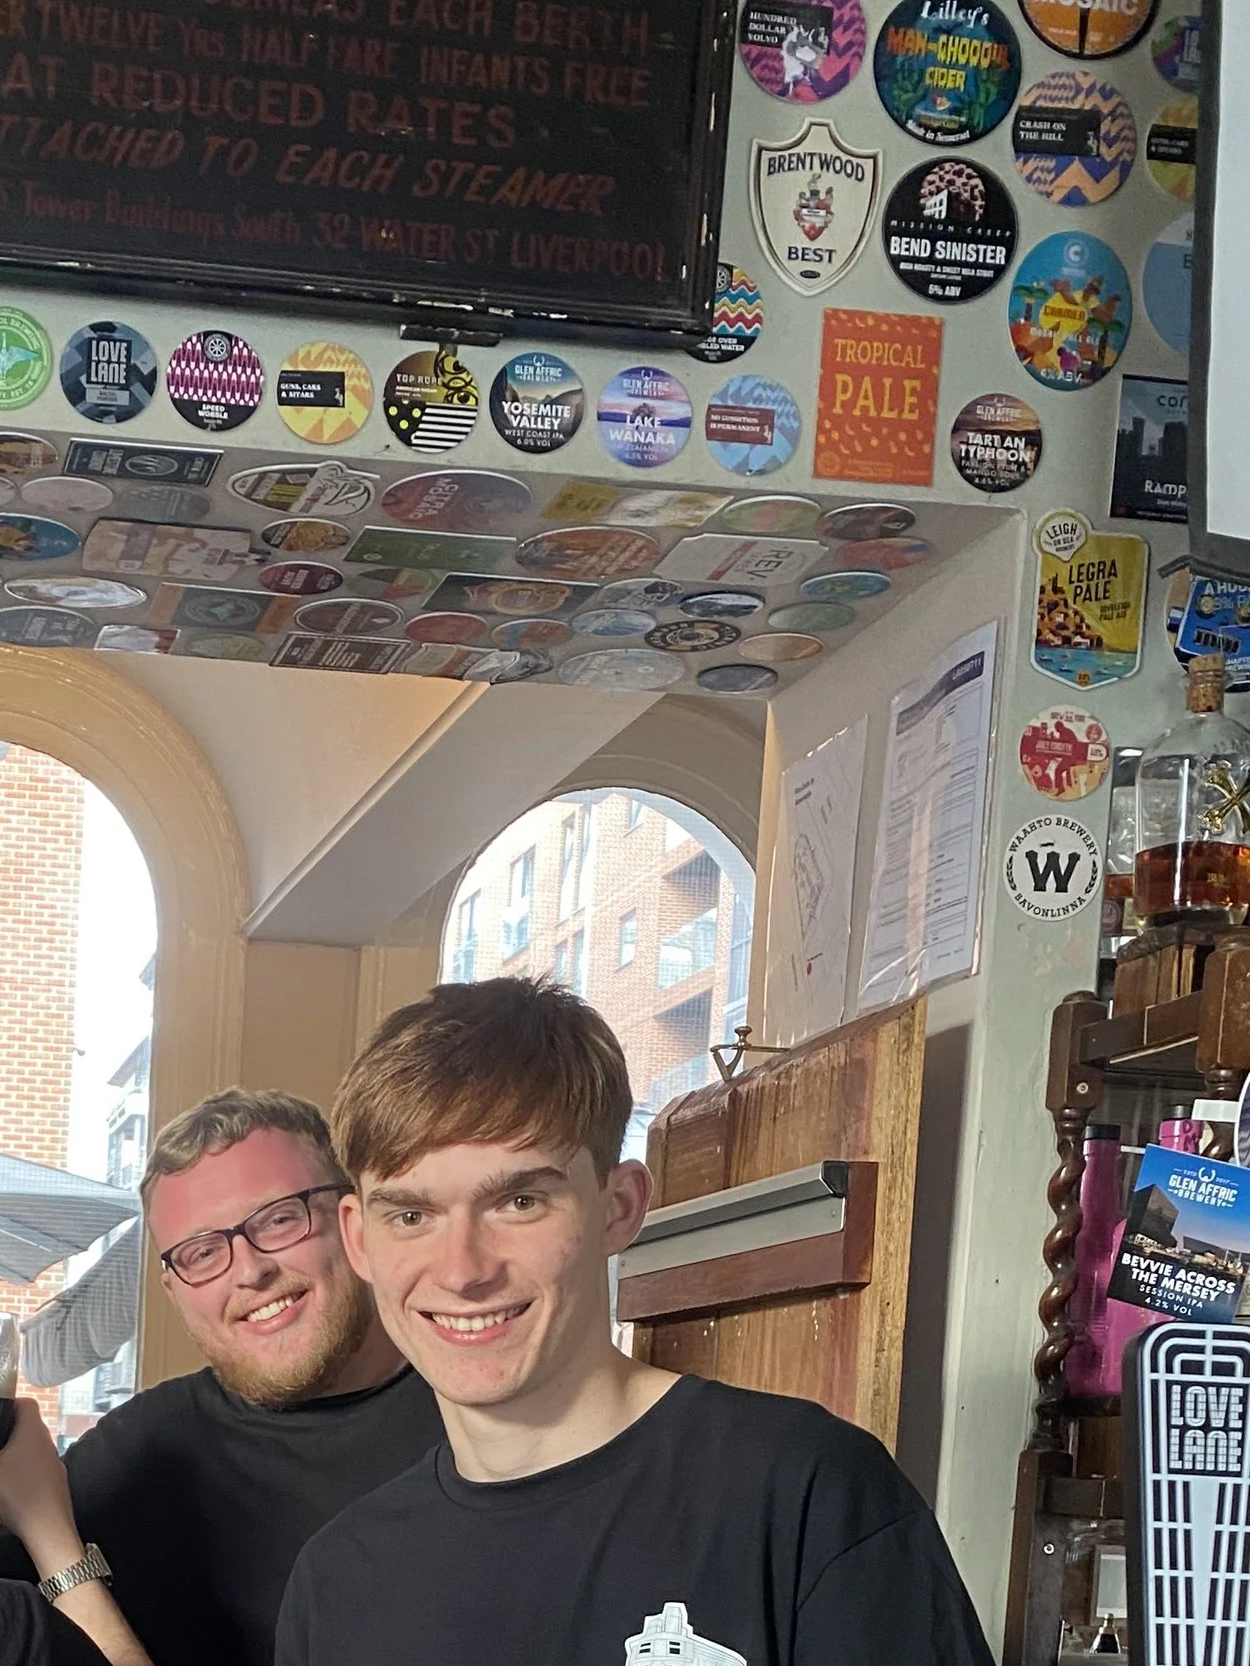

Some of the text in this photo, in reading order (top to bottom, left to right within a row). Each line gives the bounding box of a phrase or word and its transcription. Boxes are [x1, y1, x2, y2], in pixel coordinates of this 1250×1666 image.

[513, 1, 651, 56] BERTH
[420, 46, 550, 96] INFANTS
[564, 60, 651, 108] FREE
[0, 51, 62, 101] AT
[90, 60, 326, 128] REDUCED
[347, 88, 517, 149] RATES
[199, 135, 260, 178] TO
[273, 143, 405, 195] EACH
[410, 157, 617, 217] STEAMER
[766, 151, 866, 183] BRENTWOOD
[786, 245, 837, 265] BEST
[889, 235, 1006, 266] BEND SINISTER
[90, 339, 127, 363] LOVE
[833, 338, 925, 369] TROPICAL
[90, 361, 127, 384] LANE
[502, 400, 571, 419] YOSEMITE
[832, 372, 922, 421] PALE
[509, 414, 561, 430] VALLEY
[625, 413, 662, 429] LAKE
[958, 444, 1031, 463] TYPHOON
[966, 431, 1026, 450] TART AN
[1046, 523, 1078, 540] LEIGH
[1068, 558, 1118, 585] LEGRA
[1072, 580, 1112, 605] PALE
[1054, 816, 1099, 858] BREWERY
[1168, 1174, 1238, 1202] GLEN AFFRIC
[1121, 1252, 1237, 1295] BEVVIE ACROSS
[1130, 1267, 1220, 1302] THE MERSEY
[1139, 1284, 1204, 1308] SESSION IPA
[1144, 1296, 1193, 1316] 4.2% VOL
[1170, 1384, 1244, 1428] LOVE
[1168, 1428, 1242, 1472] LANE
